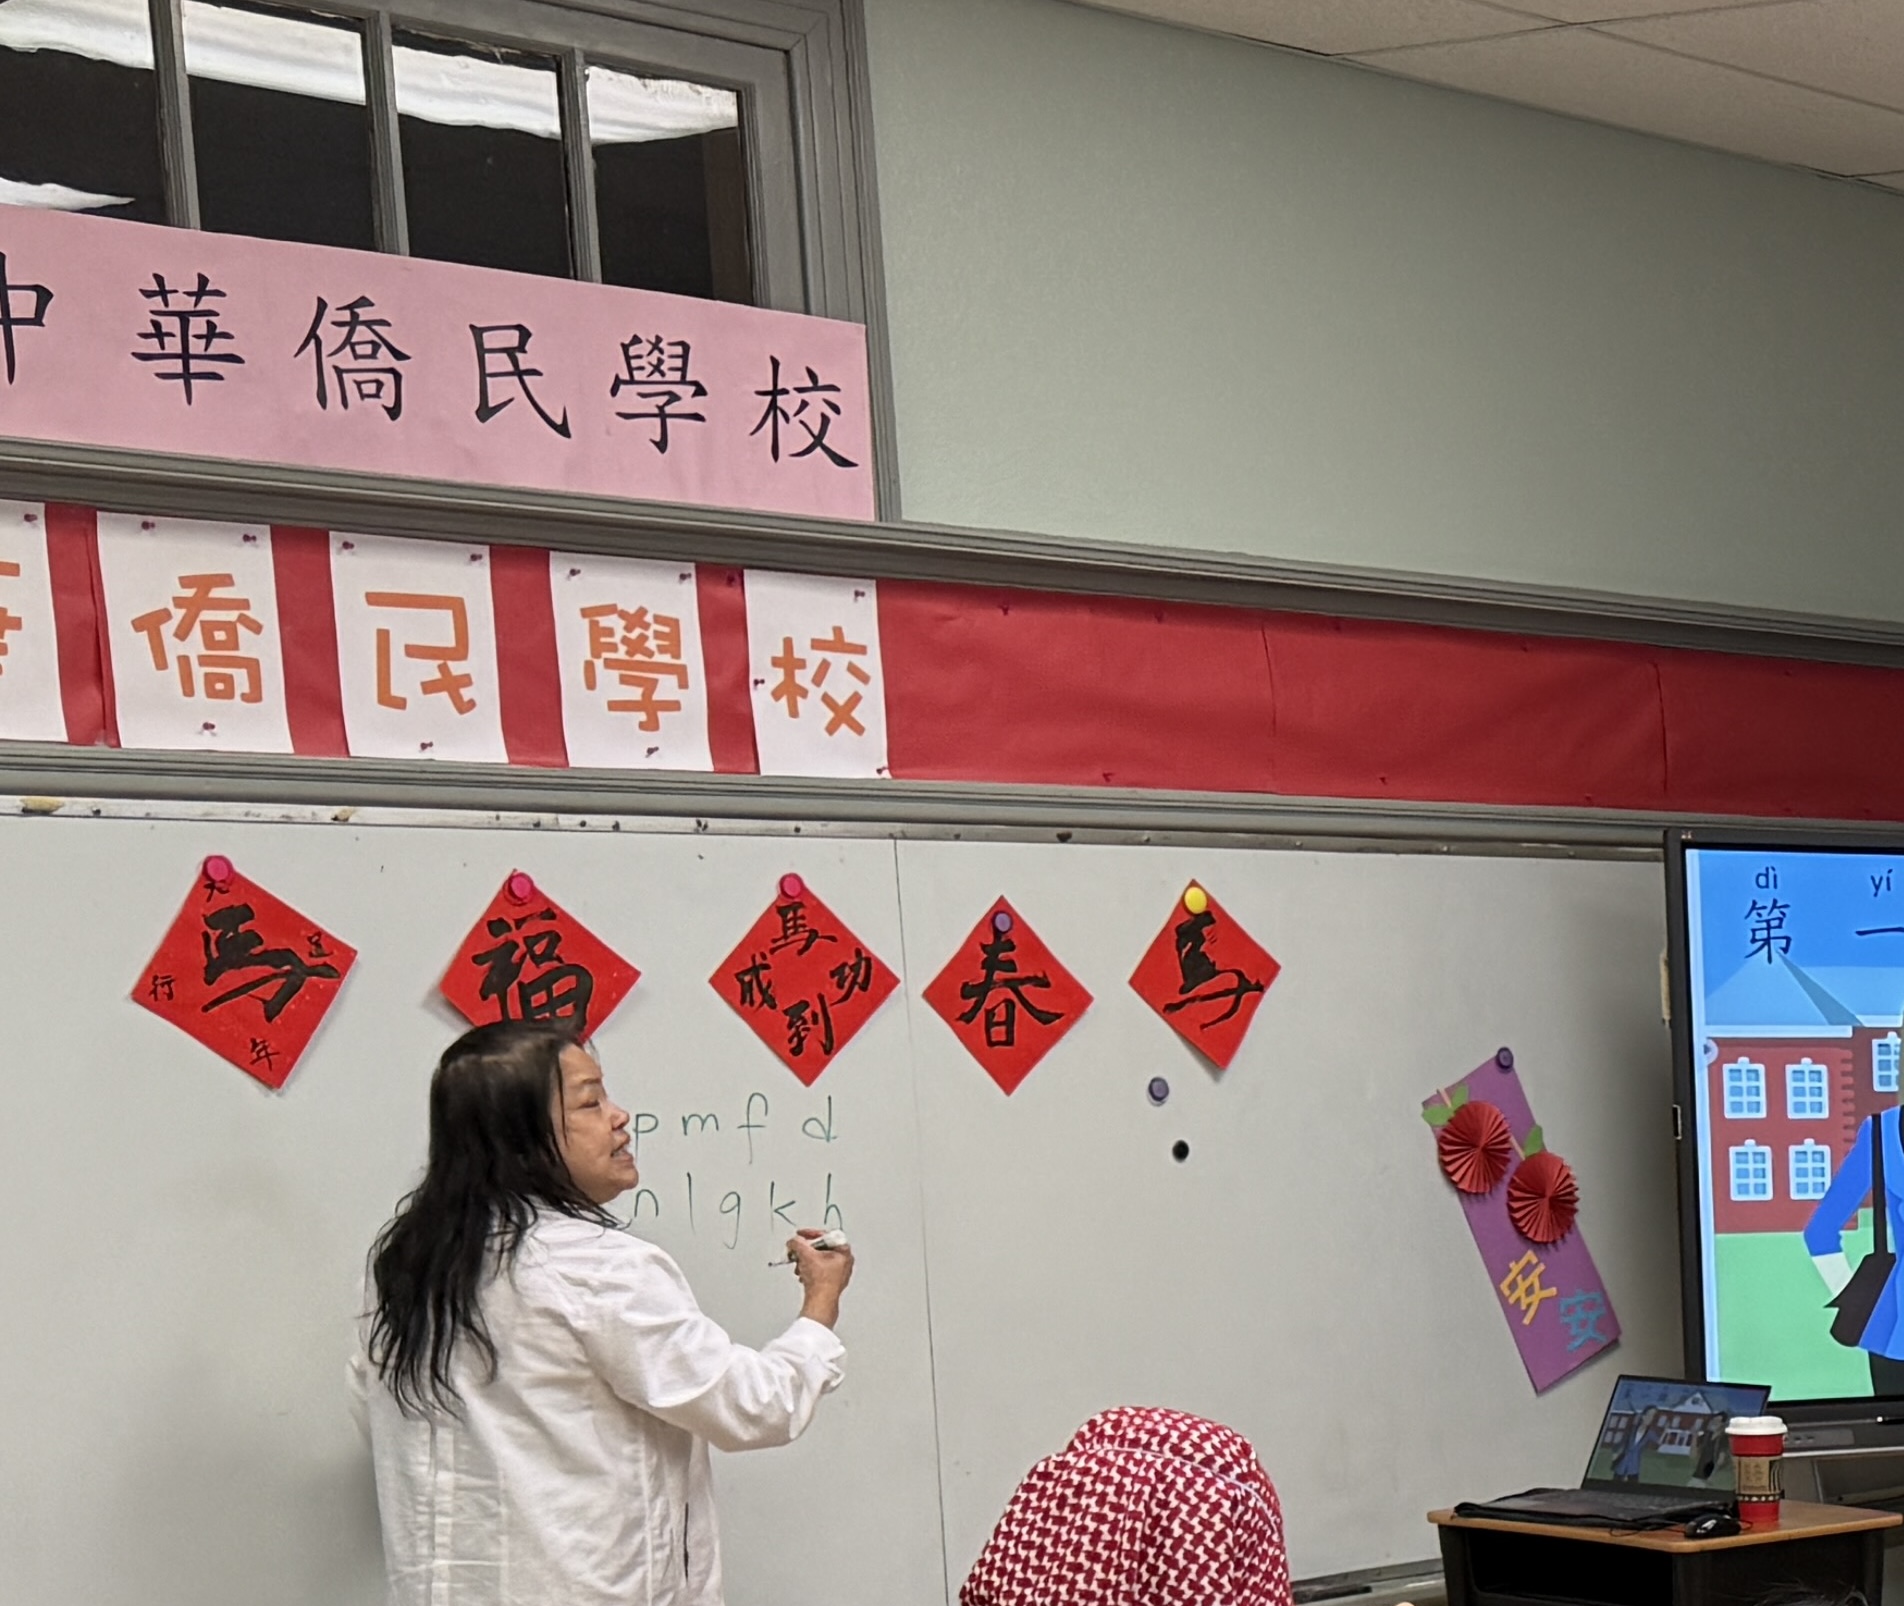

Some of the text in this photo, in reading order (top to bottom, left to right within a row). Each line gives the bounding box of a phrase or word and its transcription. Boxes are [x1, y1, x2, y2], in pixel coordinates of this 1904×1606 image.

[0, 252, 859, 468] 中華僑民學校
[1755, 867, 1778, 889] dì
[1871, 868, 1893, 896] yí
[149, 974, 176, 1001] 行
[471, 907, 594, 1024] 福
[956, 935, 1066, 1048] 春
[632, 1092, 838, 1165] p m f d
[769, 1180, 797, 1233] k
[1499, 1249, 1557, 1326] 安
[1559, 1287, 1608, 1353] 安
